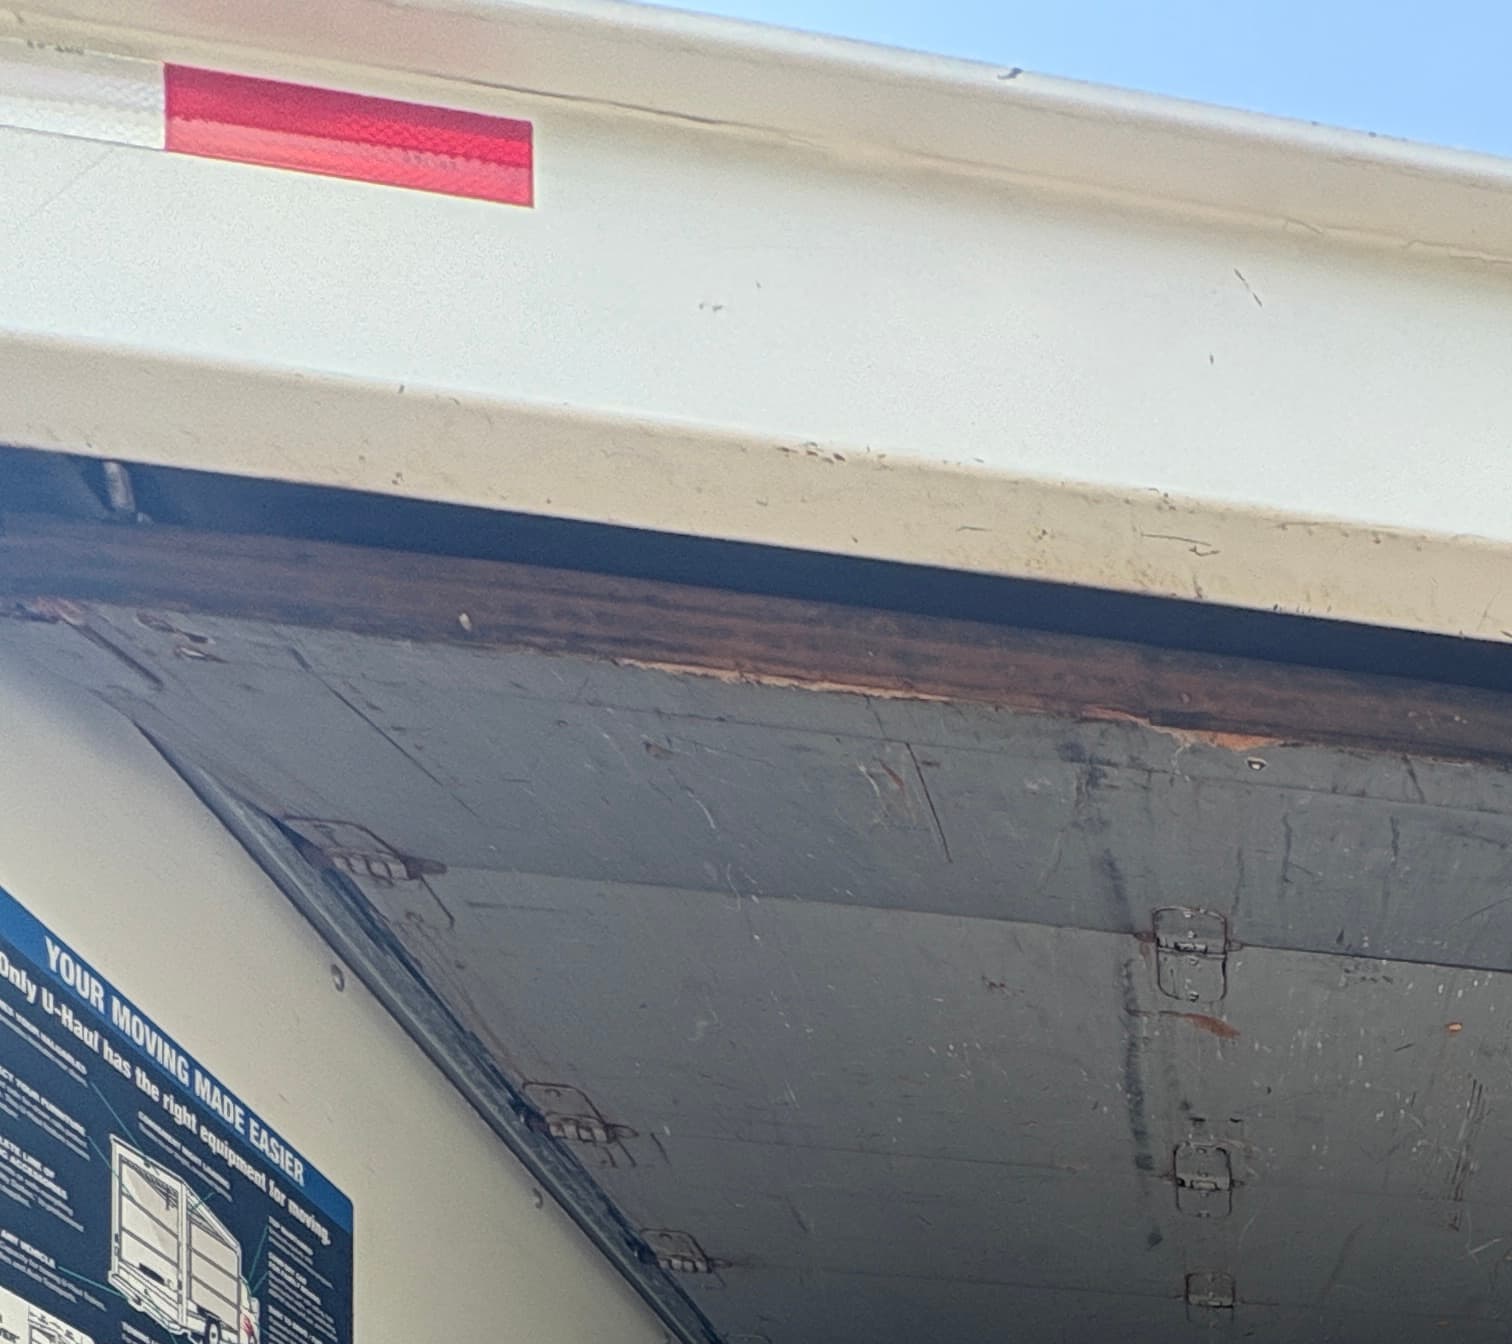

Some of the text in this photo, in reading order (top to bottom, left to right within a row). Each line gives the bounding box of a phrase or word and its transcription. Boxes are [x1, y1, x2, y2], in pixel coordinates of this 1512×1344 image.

[42, 986, 100, 1053] U-Haul
[103, 1036, 131, 1079] has
[135, 1066, 160, 1103] the
[162, 1093, 198, 1135] right
[200, 1124, 267, 1193] equipment
[268, 1179, 287, 1208] for
[45, 935, 105, 1015] YOUR
[111, 995, 190, 1087] MOVING
[194, 1068, 245, 1136] MADE
[249, 1116, 305, 1188] EASIER
